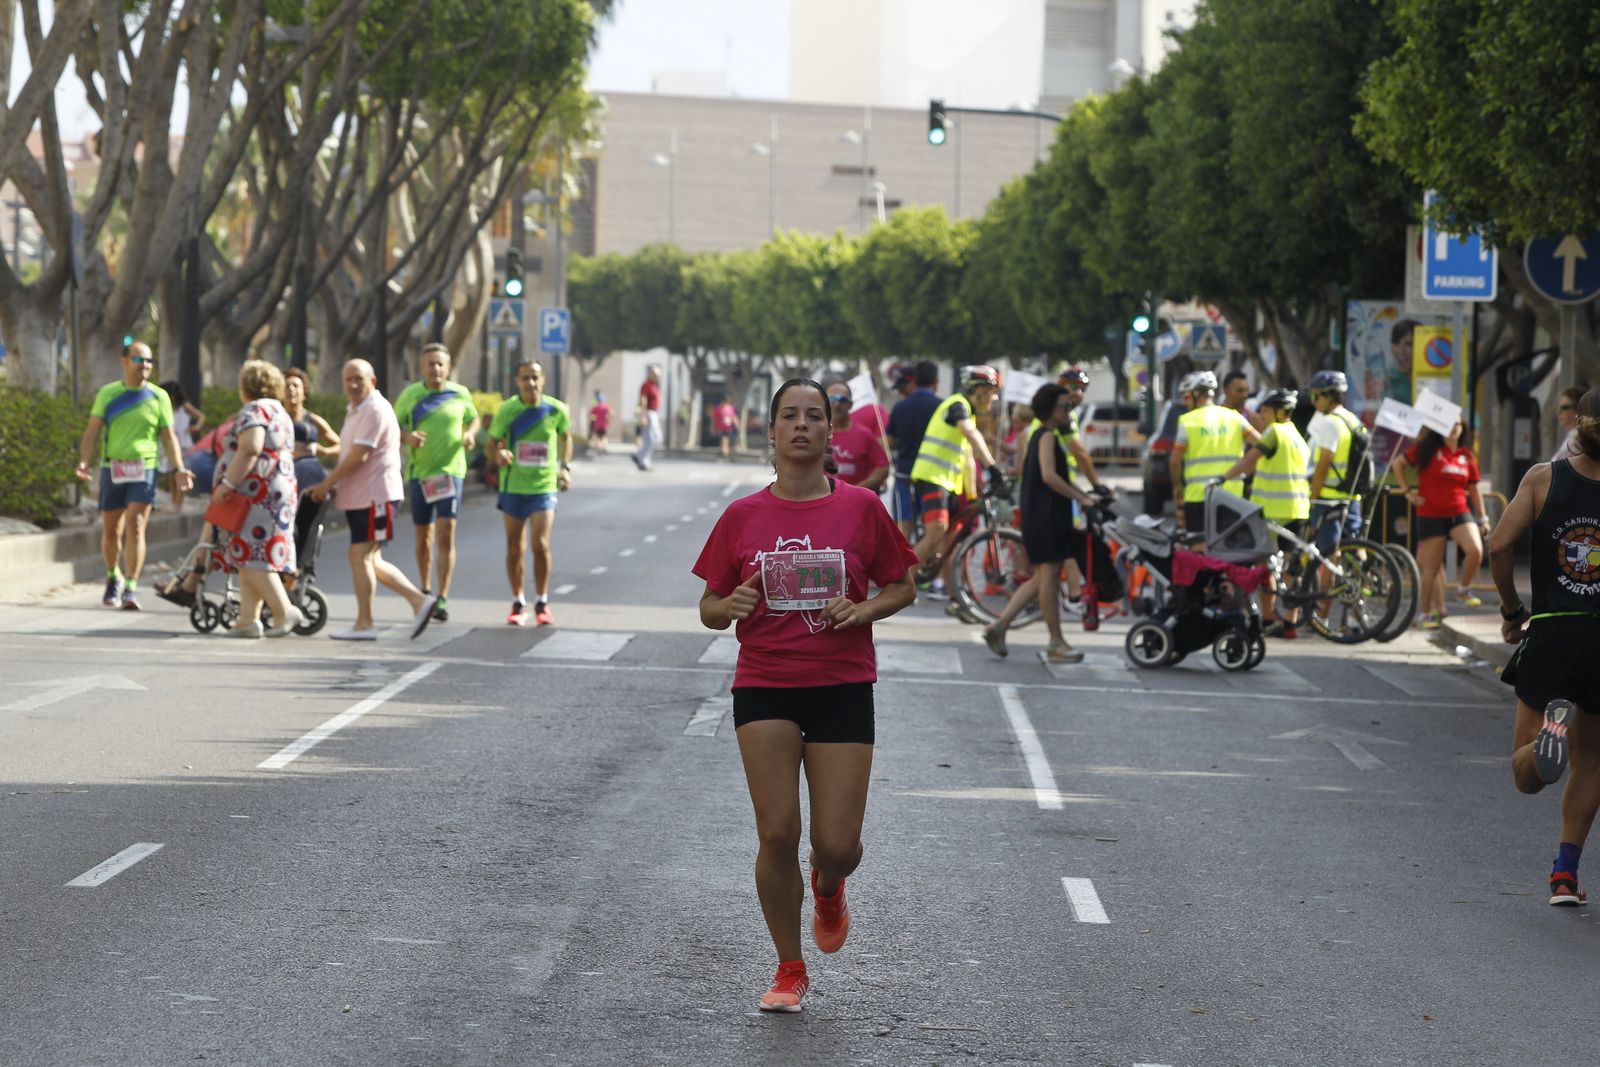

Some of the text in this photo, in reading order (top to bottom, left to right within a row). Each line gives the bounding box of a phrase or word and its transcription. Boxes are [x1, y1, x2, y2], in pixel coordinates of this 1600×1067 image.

[1434, 276, 1485, 289] PARKING
[1552, 516, 1600, 540] C.D. SANDOK
[796, 566, 836, 588] 713
